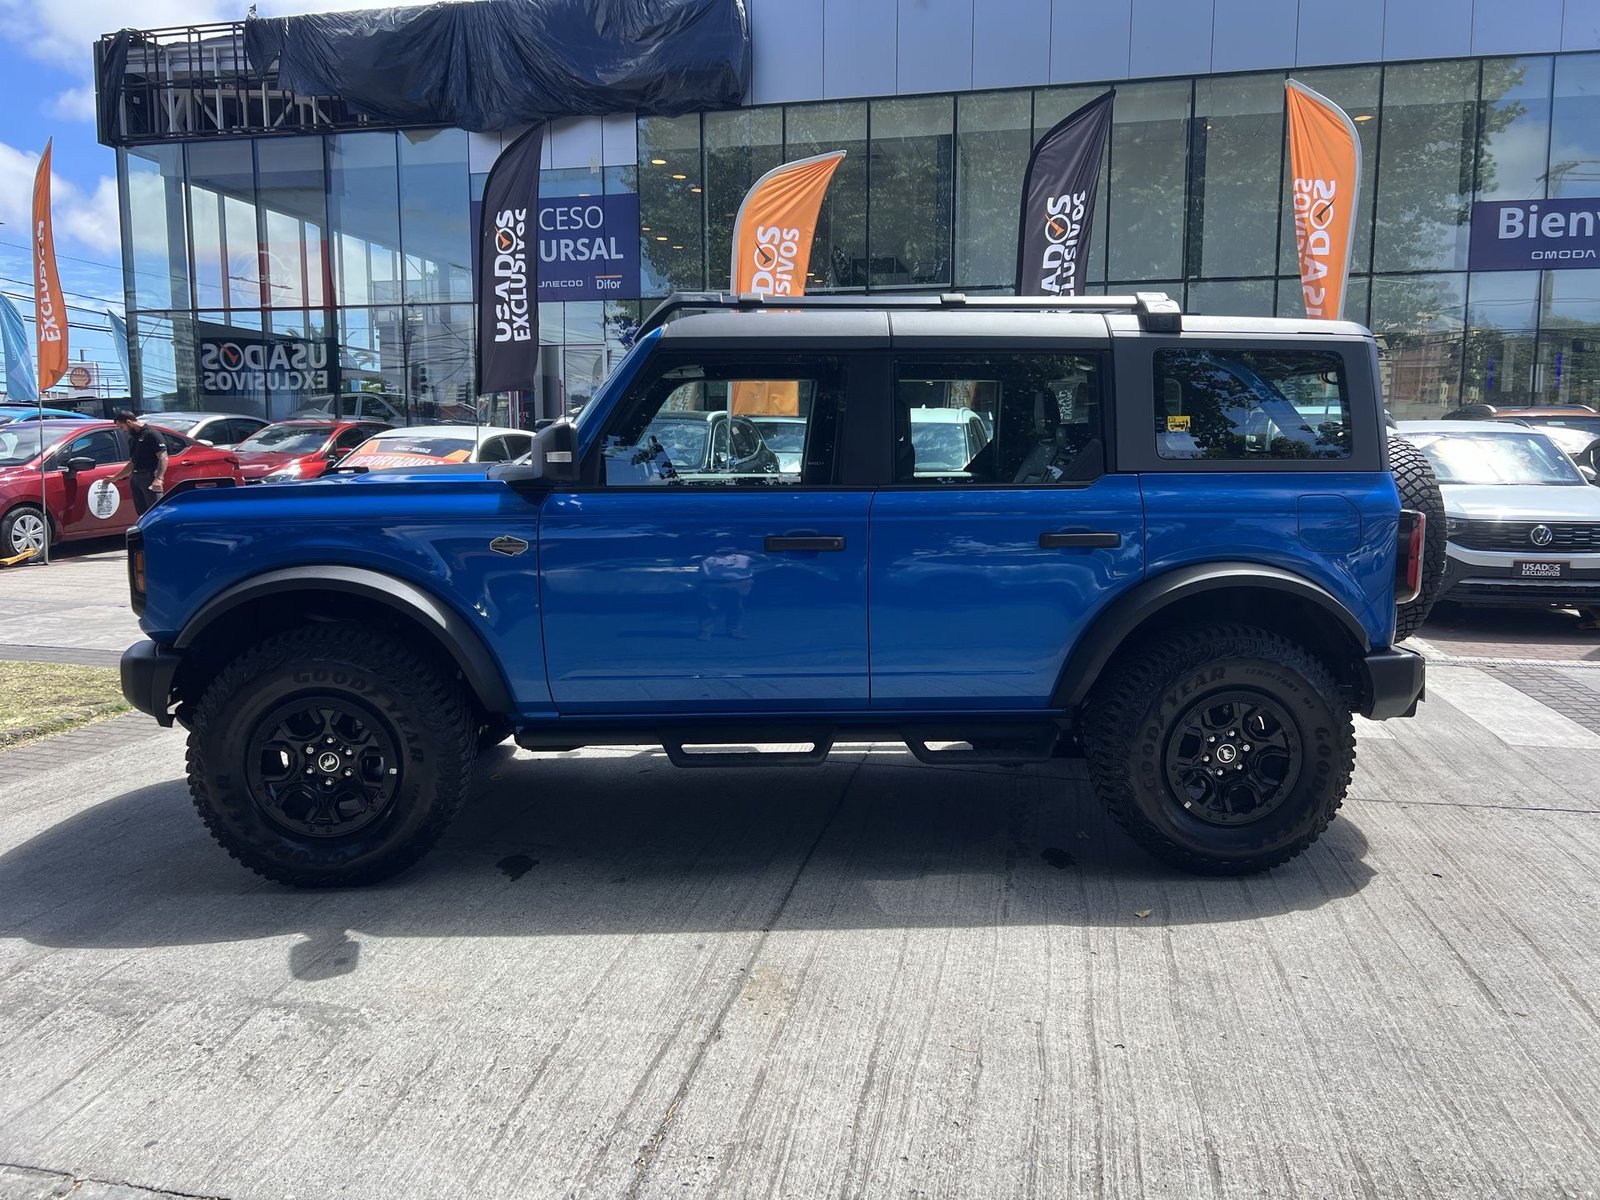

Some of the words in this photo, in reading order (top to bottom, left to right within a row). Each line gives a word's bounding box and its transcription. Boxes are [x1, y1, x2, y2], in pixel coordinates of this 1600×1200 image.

[539, 206, 604, 231] CESO
[1498, 204, 1600, 239] Bien
[540, 237, 624, 262] URSAL
[775, 227, 800, 297] SIVOS
[1531, 249, 1597, 260] OMODA
[494, 209, 517, 342] USADOS
[596, 279, 622, 290] Difor
[1522, 563, 1561, 571] USADOS
